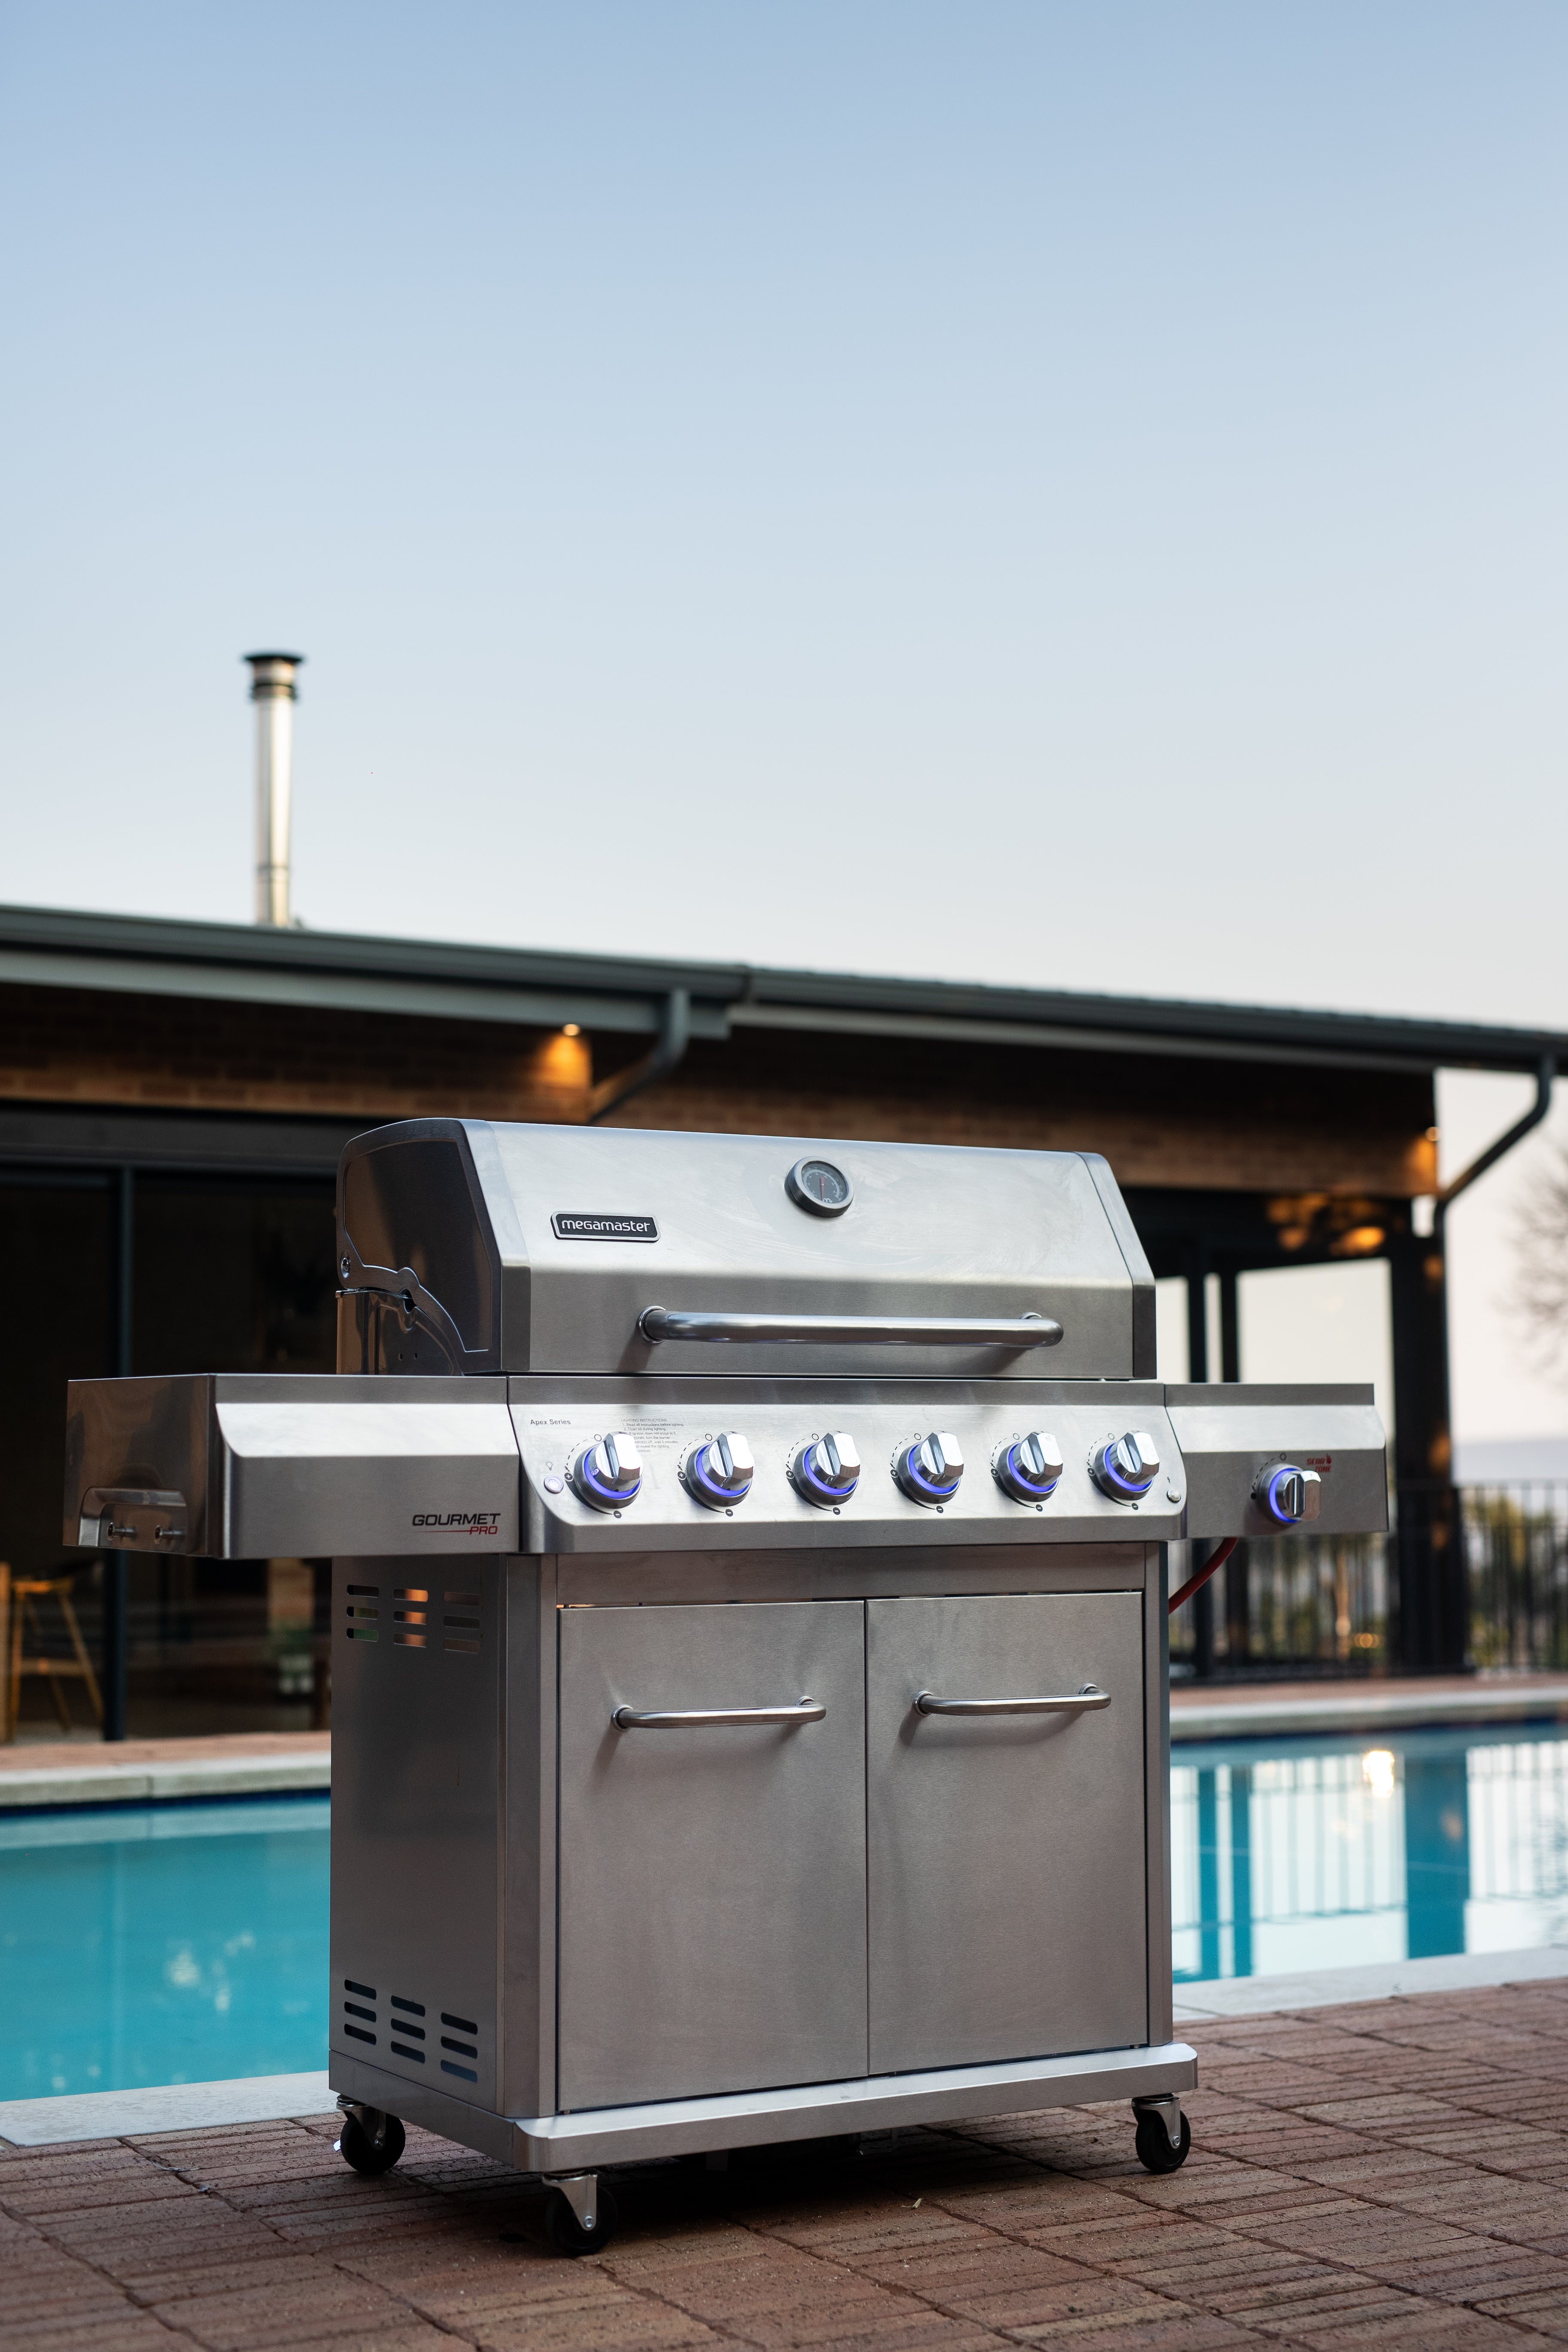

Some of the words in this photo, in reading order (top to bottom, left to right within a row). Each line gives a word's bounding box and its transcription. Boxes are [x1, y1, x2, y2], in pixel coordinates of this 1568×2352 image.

[561, 1220, 650, 1232] megamaster
[413, 1513, 501, 1526] GOURMET
[469, 1526, 498, 1535] PRO
